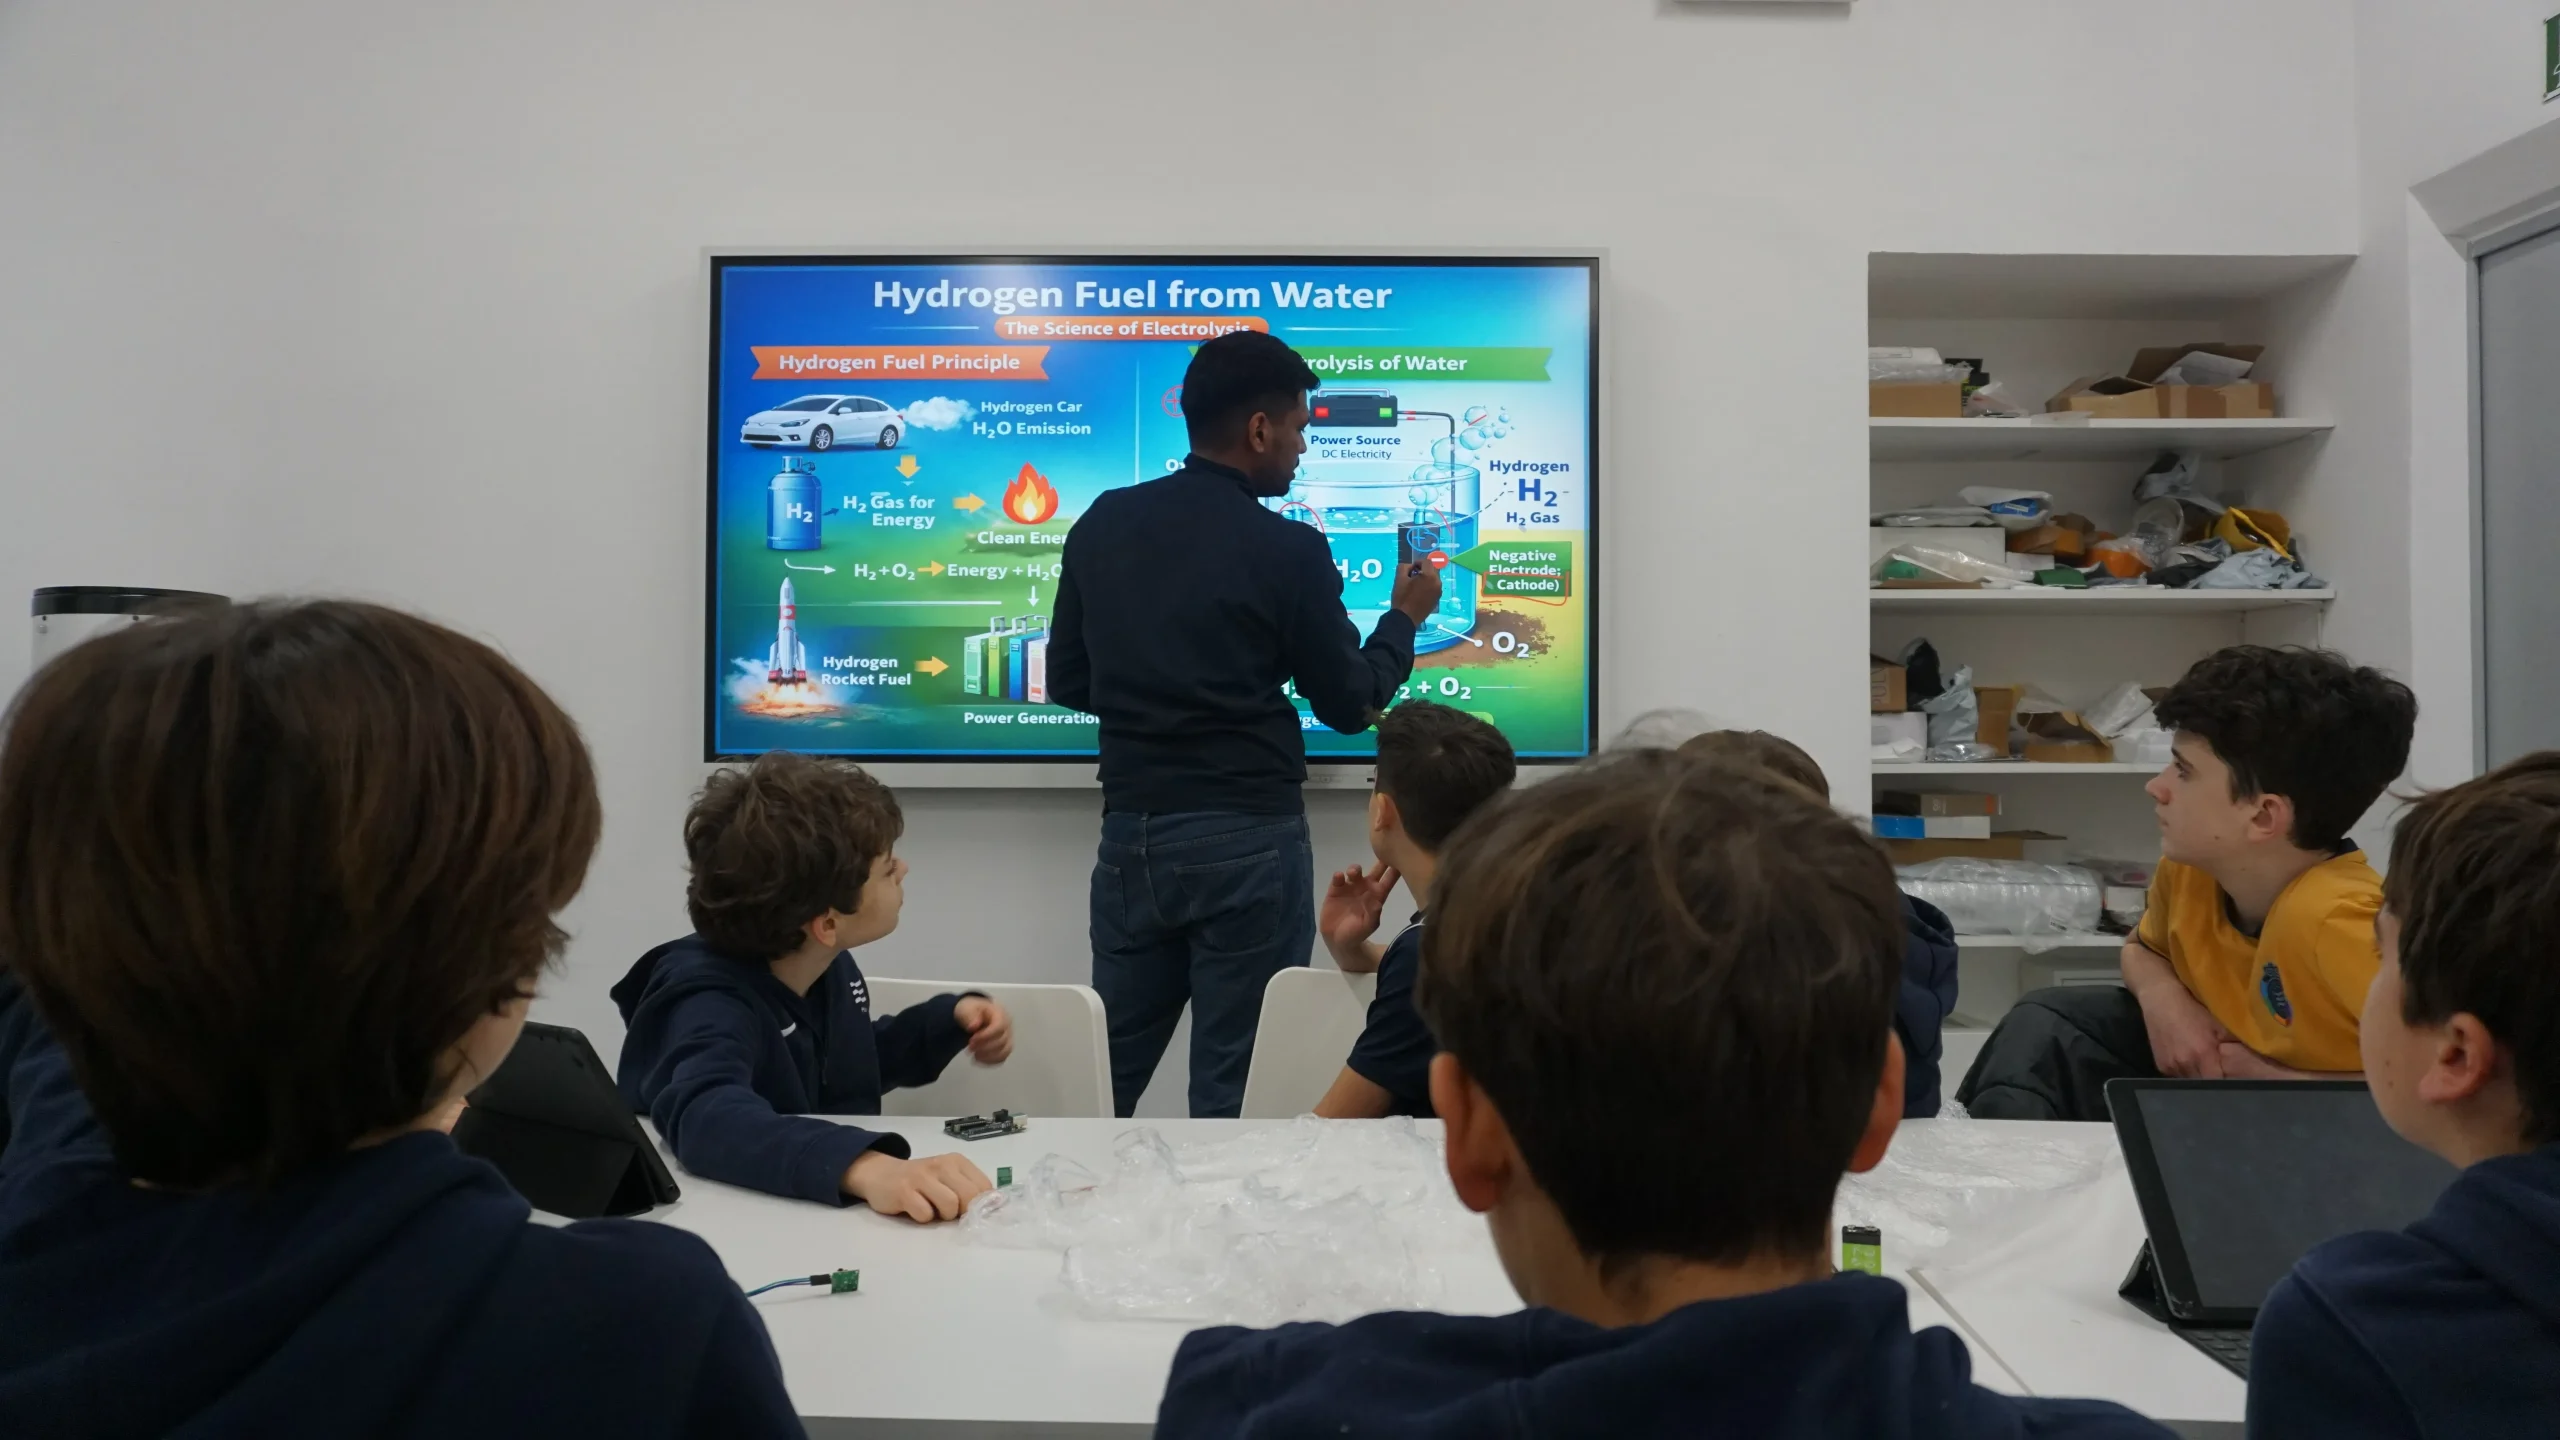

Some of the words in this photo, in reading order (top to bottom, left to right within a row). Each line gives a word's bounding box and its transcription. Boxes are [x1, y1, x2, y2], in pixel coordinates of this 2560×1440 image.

[873, 279, 1063, 315] Hydrogen
[1075, 279, 1155, 309] Fuel
[1167, 279, 1261, 309] from
[1271, 281, 1392, 310] Water
[1004, 321, 1039, 336] The
[1044, 320, 1114, 336] Science
[1118, 320, 1139, 336] of
[1142, 321, 1250, 338] Electrolysis
[778, 353, 877, 375] Hydrogen
[882, 353, 926, 371] Fuel
[932, 353, 1020, 375] Principle
[1302, 354, 1374, 374] rolysis
[1379, 353, 1401, 372] of
[1405, 356, 1468, 372] Water
[980, 400, 1052, 416] Hydrogen
[1057, 401, 1083, 413] Car
[1016, 422, 1091, 436] Emission
[1310, 434, 1352, 446] Power
[1356, 433, 1401, 446] Source
[1321, 448, 1337, 460] DC
[1341, 447, 1392, 462] Electricity
[1489, 459, 1570, 475] Hydrogen
[870, 495, 905, 509] Gas
[909, 494, 936, 509] for
[872, 513, 936, 530] Energy
[1530, 511, 1561, 524] Gas
[977, 531, 1025, 545] Clean
[1029, 531, 1067, 545] Ener
[1488, 550, 1557, 564] Negative
[947, 563, 1008, 581] Energy
[1496, 579, 1560, 592] Cathode)
[823, 656, 898, 671] Hydrogen
[821, 672, 875, 687] Rocket
[880, 672, 912, 687] Fuel
[964, 712, 1014, 725] Power
